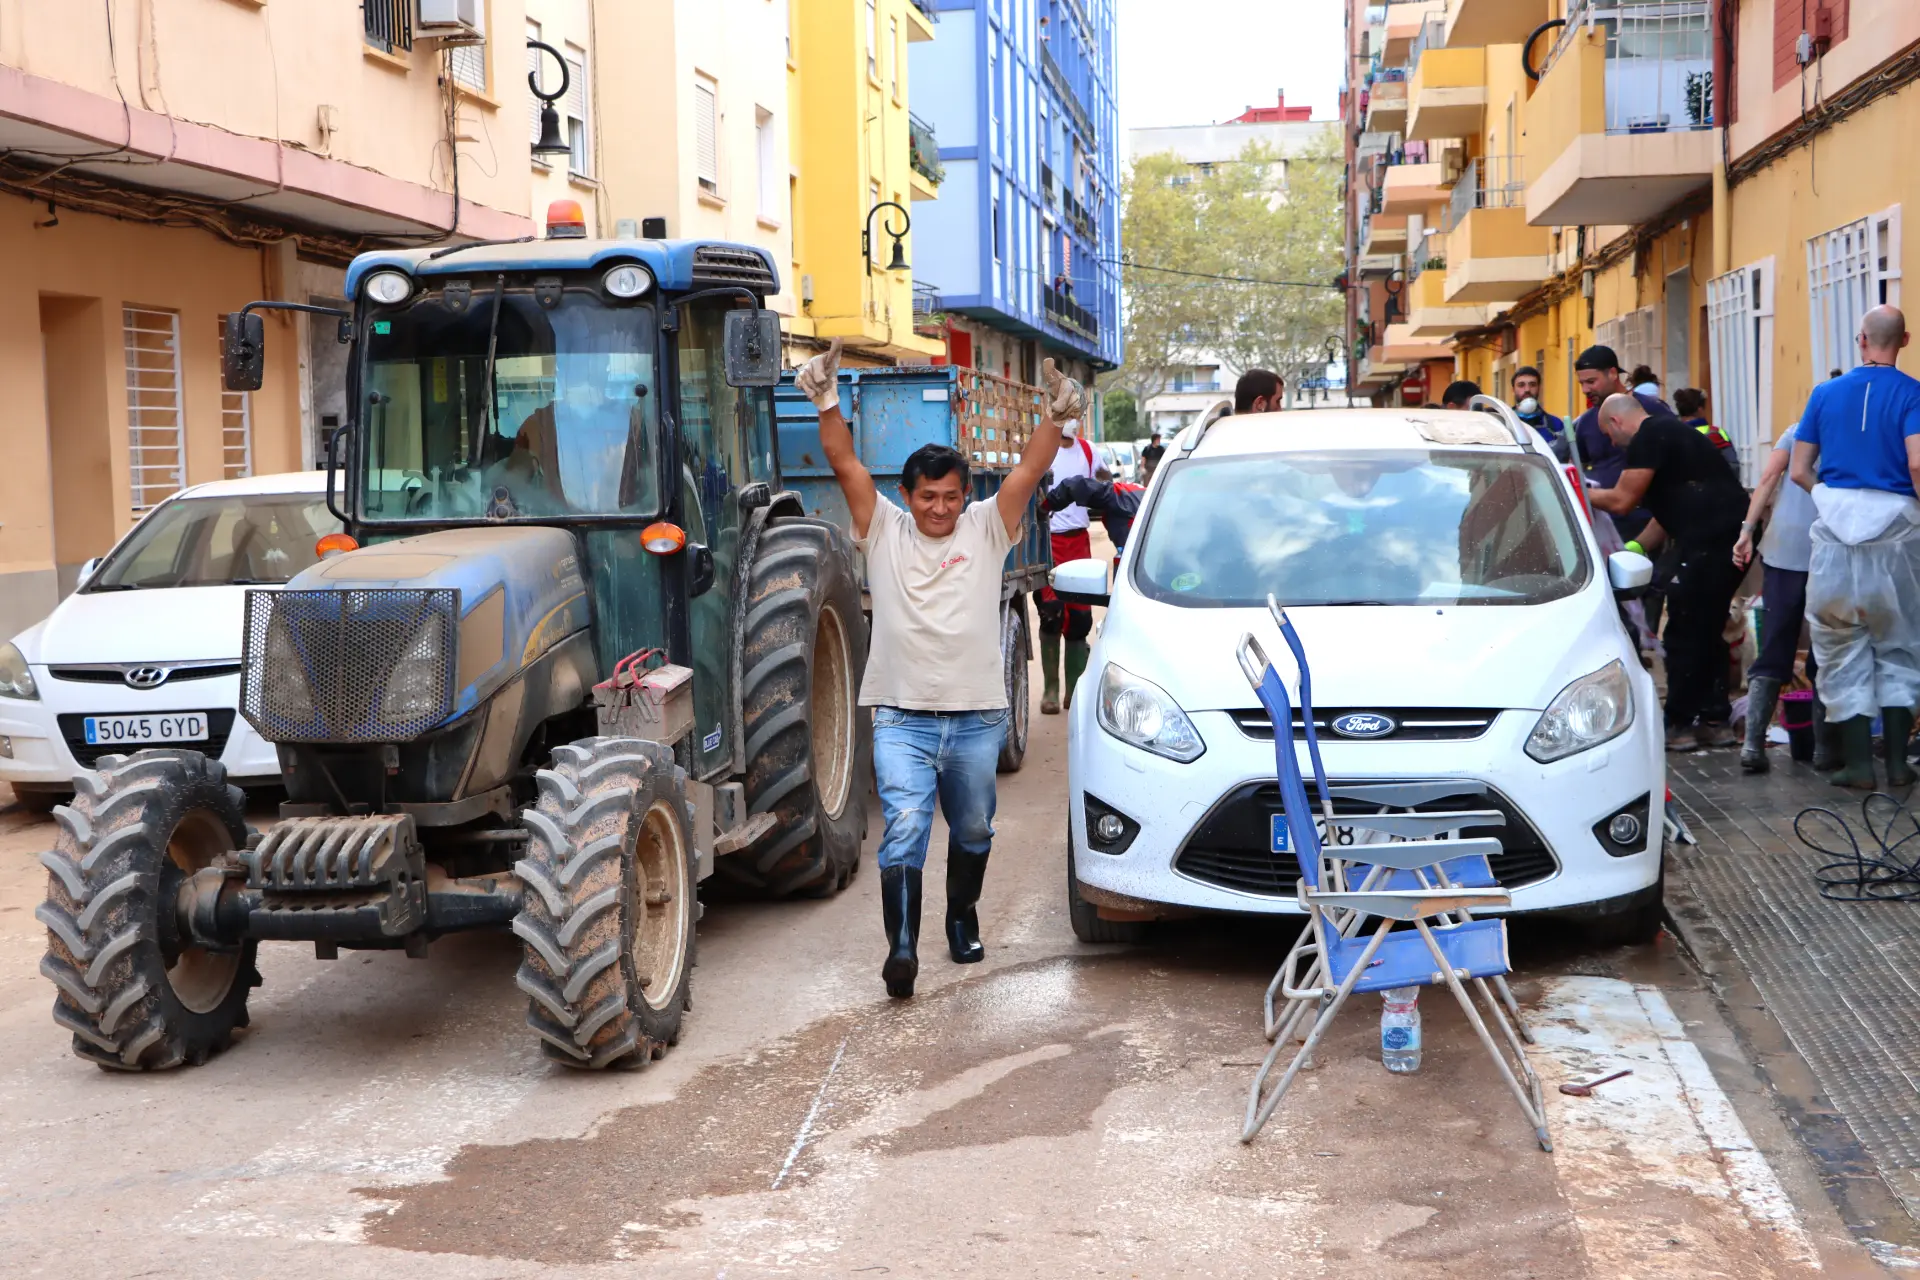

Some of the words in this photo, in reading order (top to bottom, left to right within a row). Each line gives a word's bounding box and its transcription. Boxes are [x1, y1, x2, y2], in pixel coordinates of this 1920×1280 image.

[99, 720, 151, 739] 5045
[160, 717, 200, 738] GYD
[1345, 716, 1380, 731] Ford
[1277, 837, 1284, 845] E
